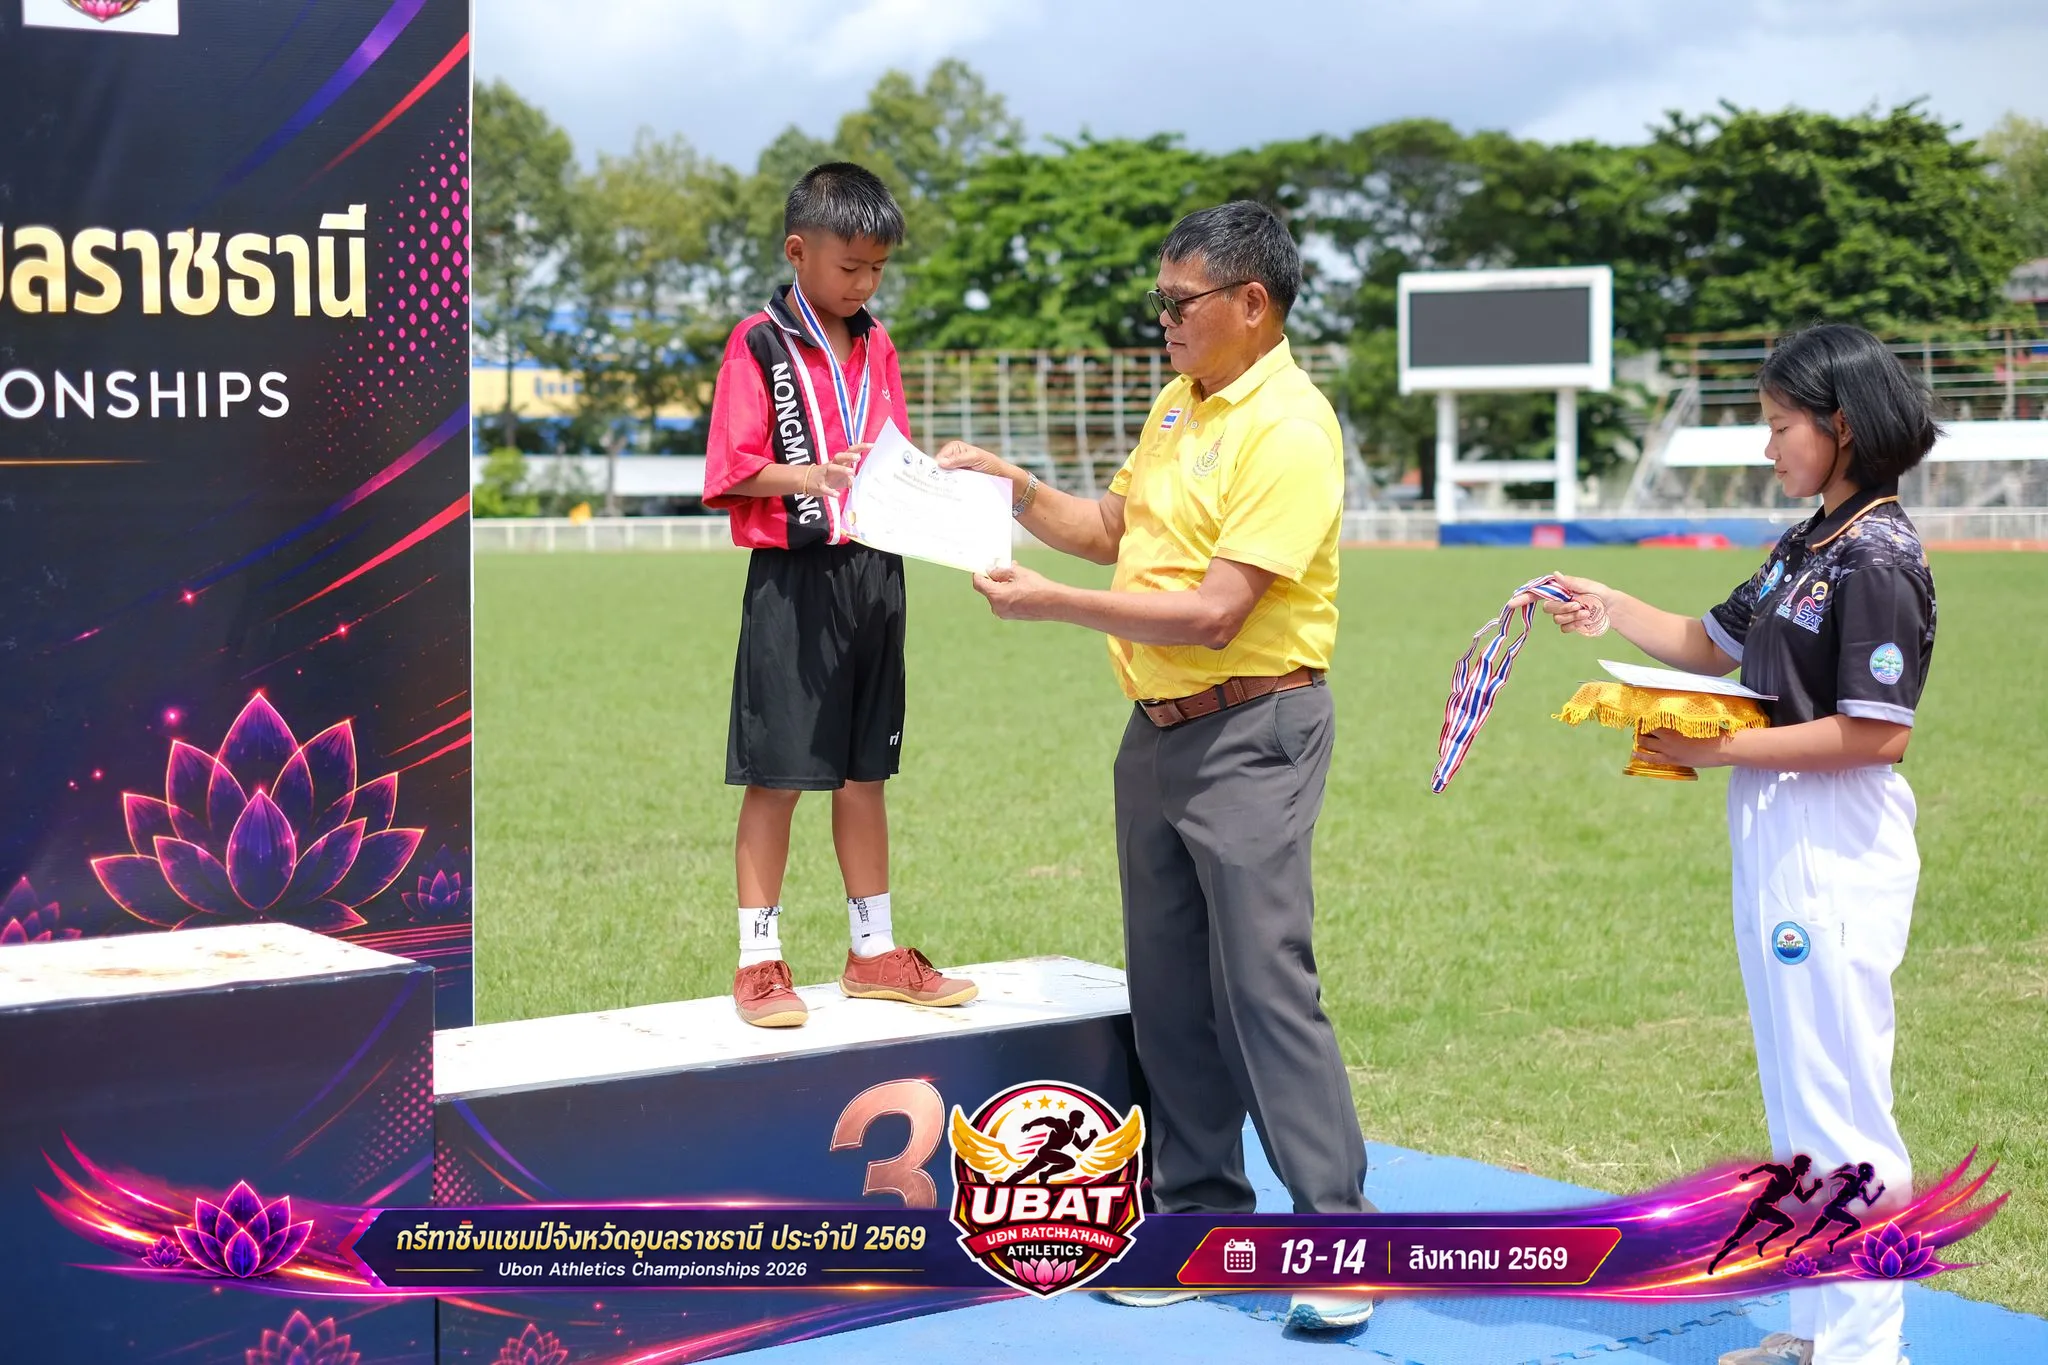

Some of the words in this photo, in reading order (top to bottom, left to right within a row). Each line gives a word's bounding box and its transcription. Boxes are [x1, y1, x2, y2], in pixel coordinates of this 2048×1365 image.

[0, 203, 367, 318] ลราชธานี
[830, 1078, 946, 1208] 3
